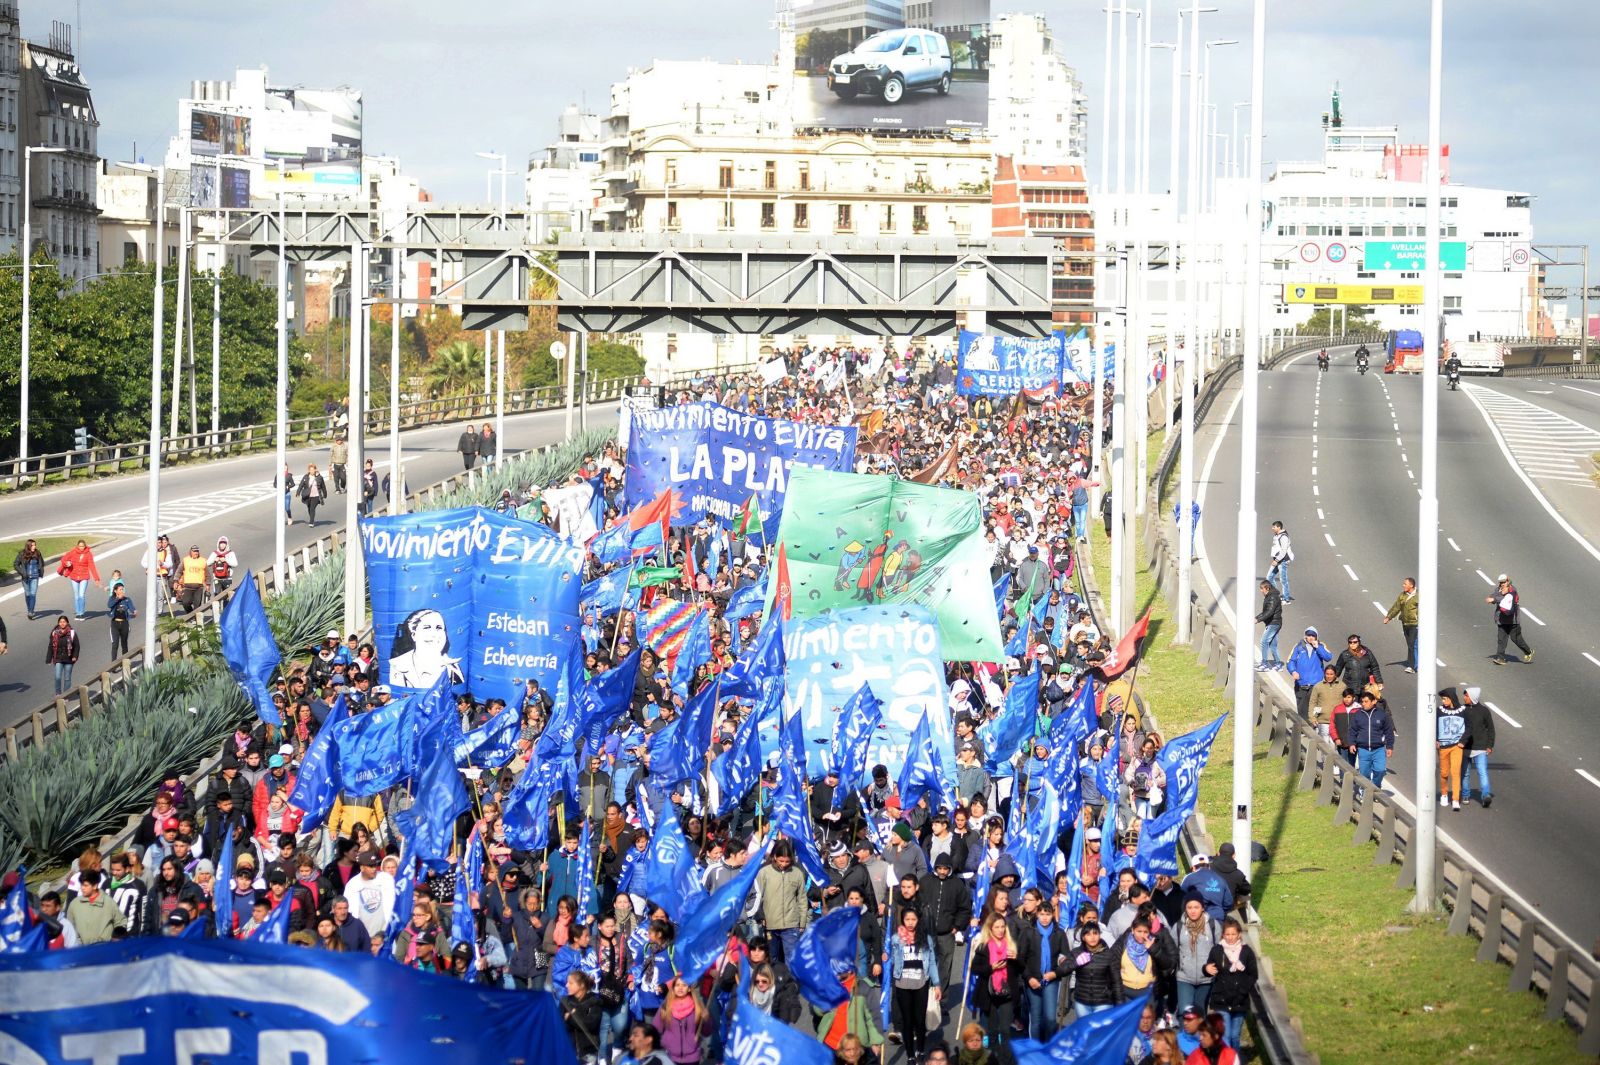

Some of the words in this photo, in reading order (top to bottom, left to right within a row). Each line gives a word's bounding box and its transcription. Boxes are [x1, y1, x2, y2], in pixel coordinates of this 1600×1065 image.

[1391, 243, 1426, 251] AVELLAN
[1515, 253, 1526, 261] 60
[978, 374, 1043, 389] BERISSO
[773, 420, 847, 452] Evita
[669, 443, 714, 483] LA
[722, 446, 825, 493] PLA
[362, 511, 491, 560] Movimiento
[486, 612, 549, 637] Esteban
[782, 617, 936, 661] vimiento
[483, 646, 558, 670] Echeverría
